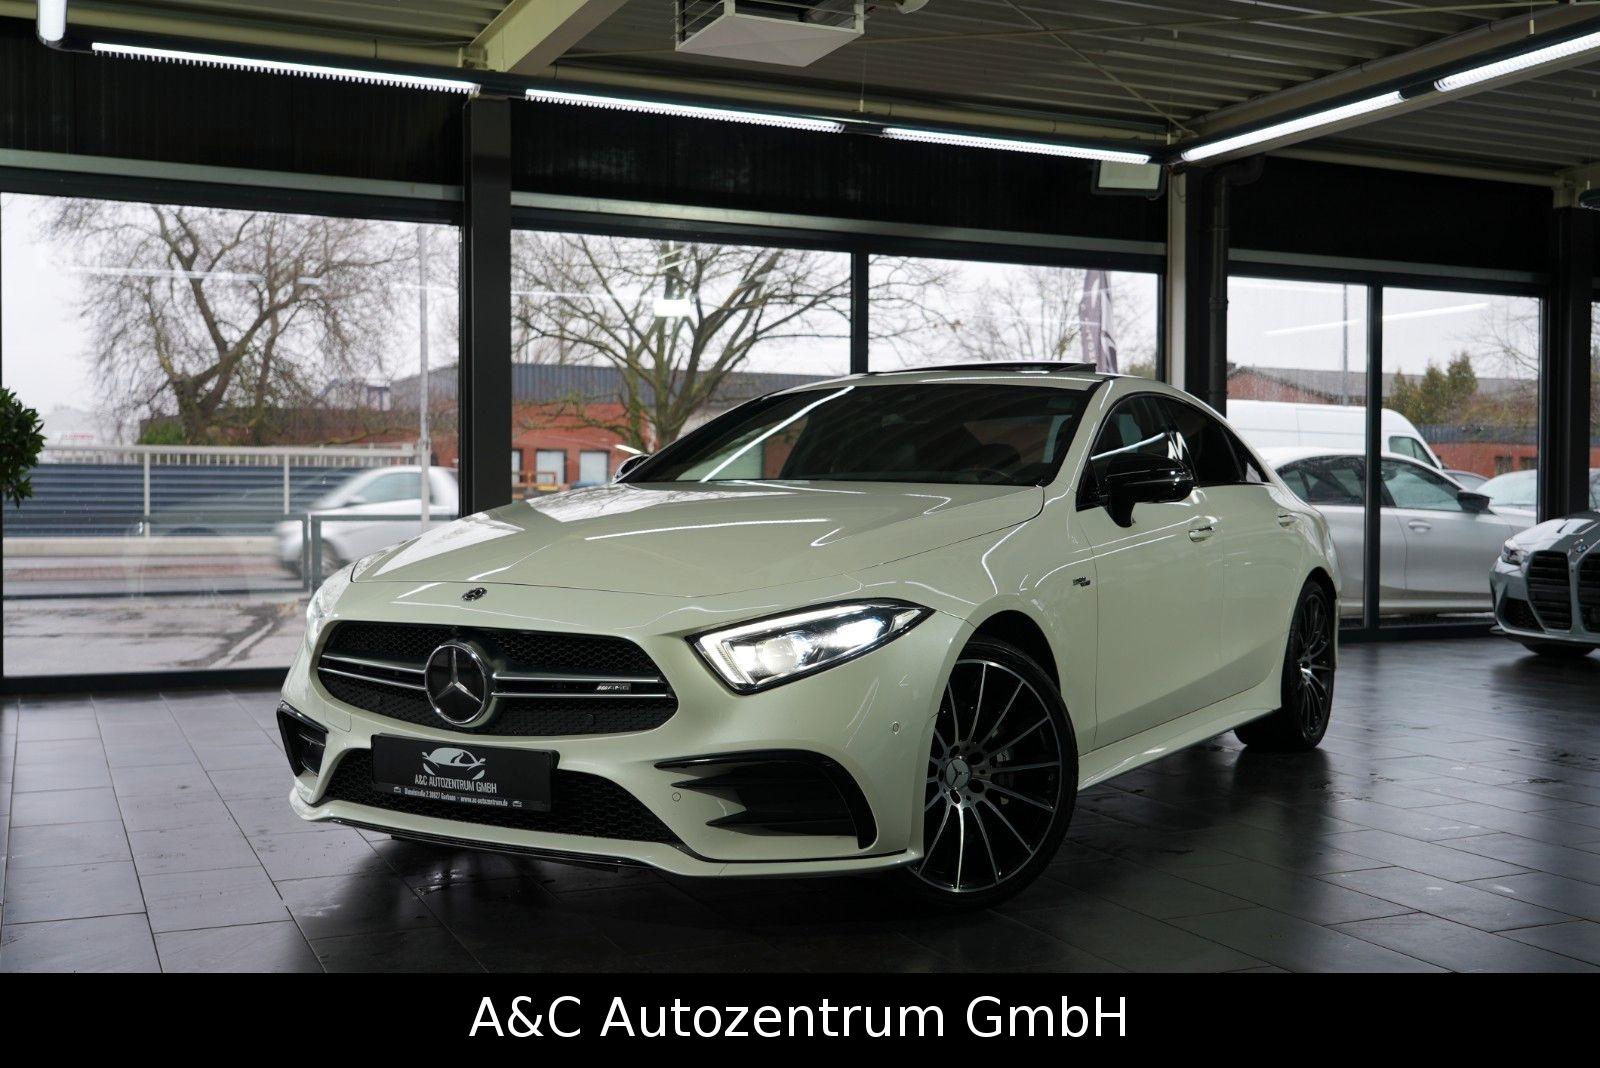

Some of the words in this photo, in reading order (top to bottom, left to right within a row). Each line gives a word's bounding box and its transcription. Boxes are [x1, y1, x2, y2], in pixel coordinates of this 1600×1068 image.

[414, 774, 427, 786] A&C
[428, 777, 475, 792] AUTOZENTRUM
[476, 781, 497, 794] GMBH
